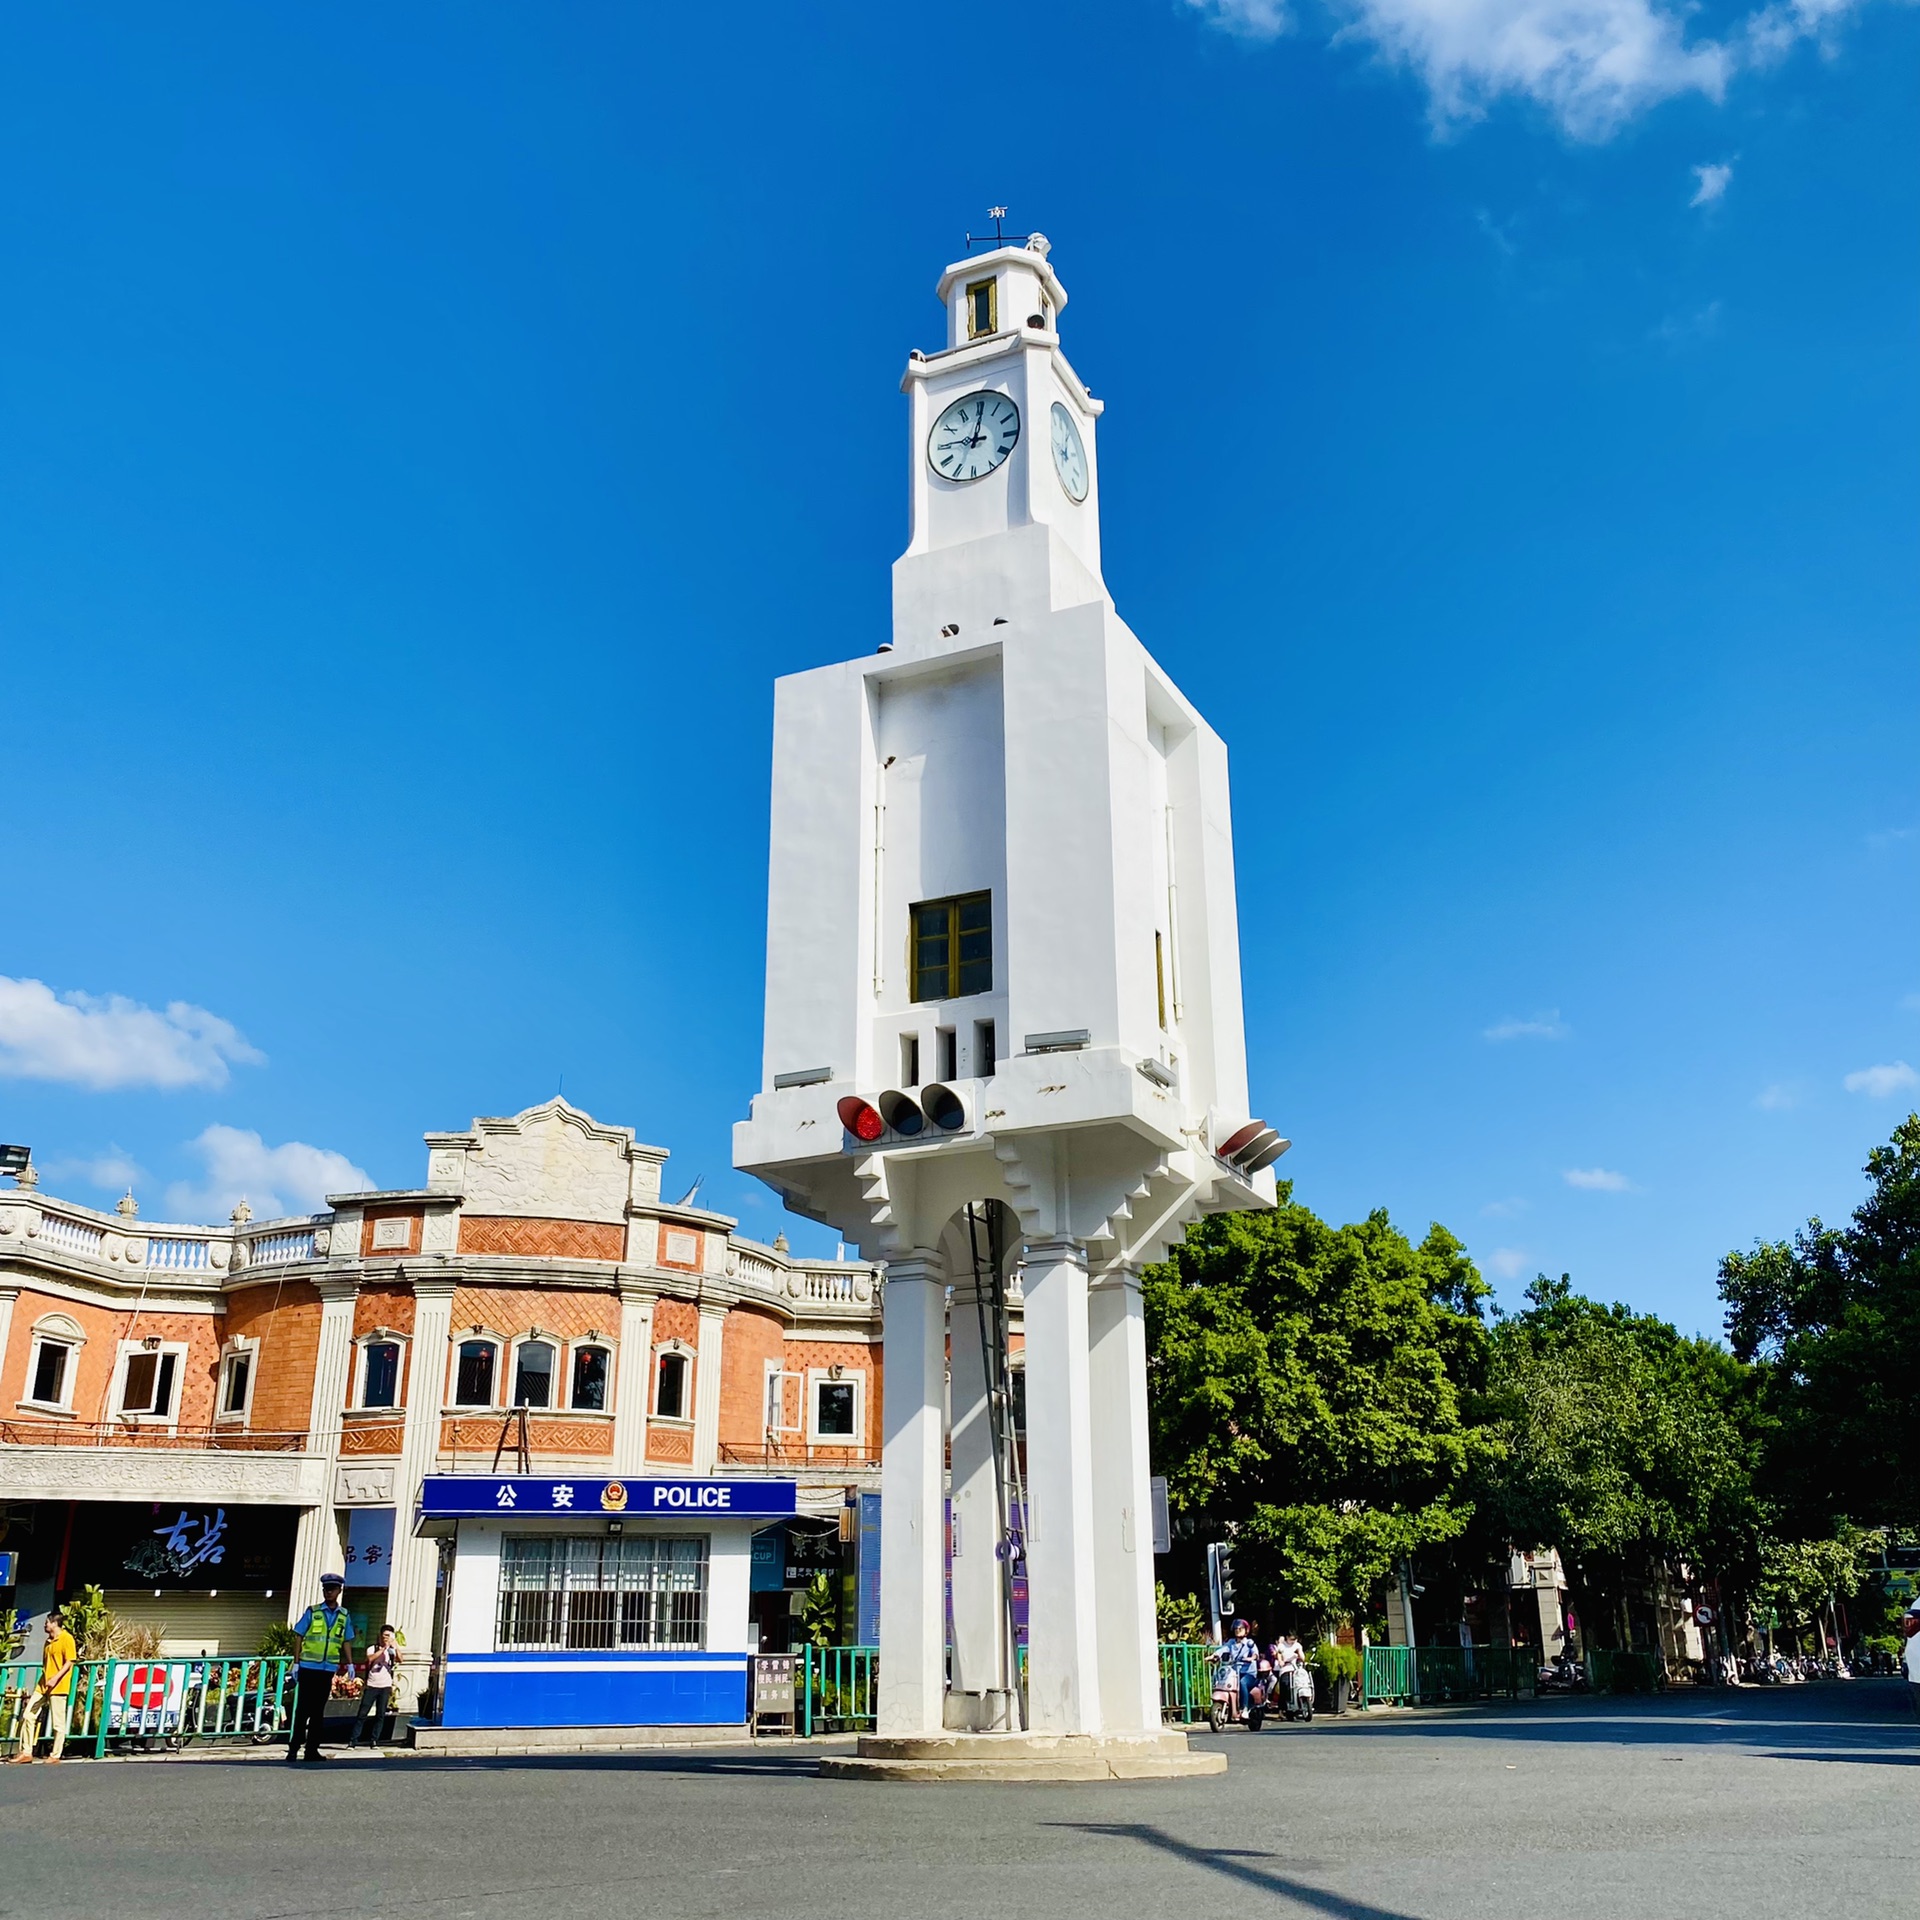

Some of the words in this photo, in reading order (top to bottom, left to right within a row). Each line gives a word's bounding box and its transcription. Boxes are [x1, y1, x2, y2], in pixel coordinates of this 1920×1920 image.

[495, 1484, 575, 1508] 公安
[653, 1486, 732, 1508] POLICE
[153, 1508, 228, 1569] 古茗
[344, 1545, 393, 1565] 品客
[752, 1552, 772, 1561] CUP
[759, 1689, 790, 1701] 服务站
